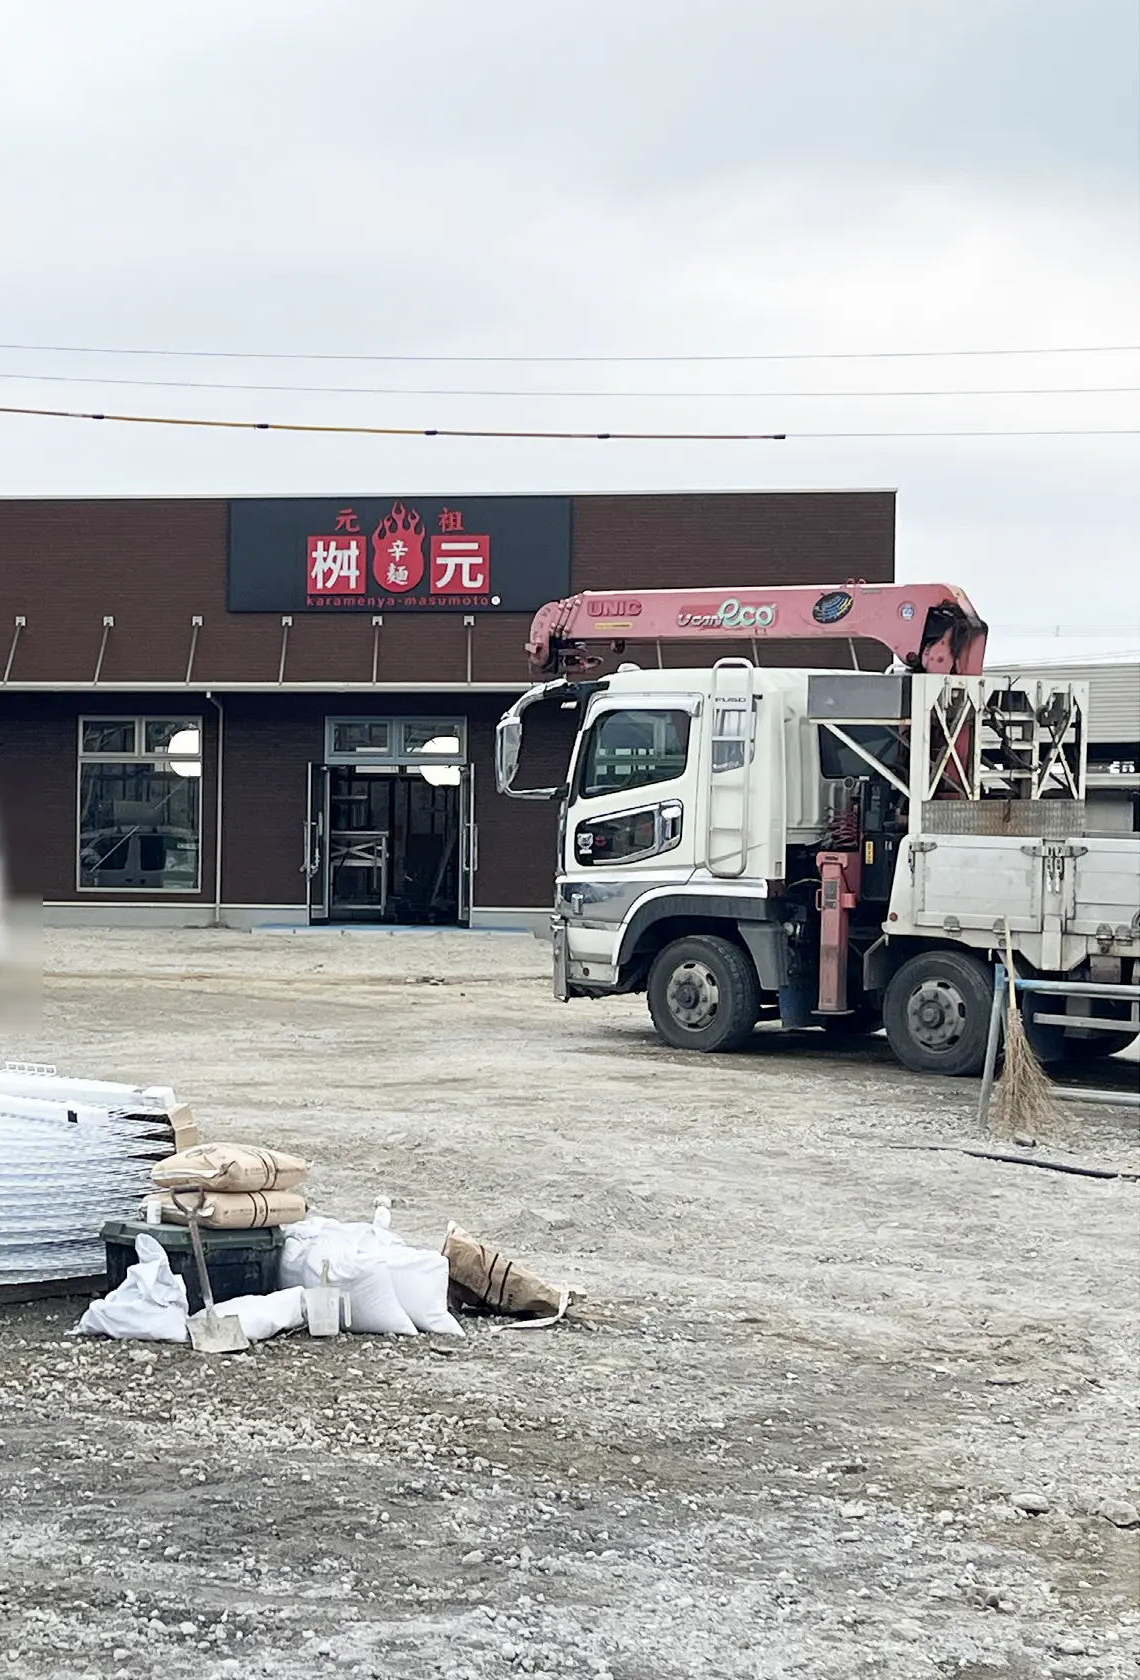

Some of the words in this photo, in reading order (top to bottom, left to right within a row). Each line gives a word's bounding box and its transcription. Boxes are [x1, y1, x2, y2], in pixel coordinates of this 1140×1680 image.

[334, 508, 360, 533] 元
[438, 506, 464, 533] 祖
[435, 542, 483, 588] 元
[306, 596, 489, 608] karamenya-masumoto
[587, 599, 642, 617] UNIC
